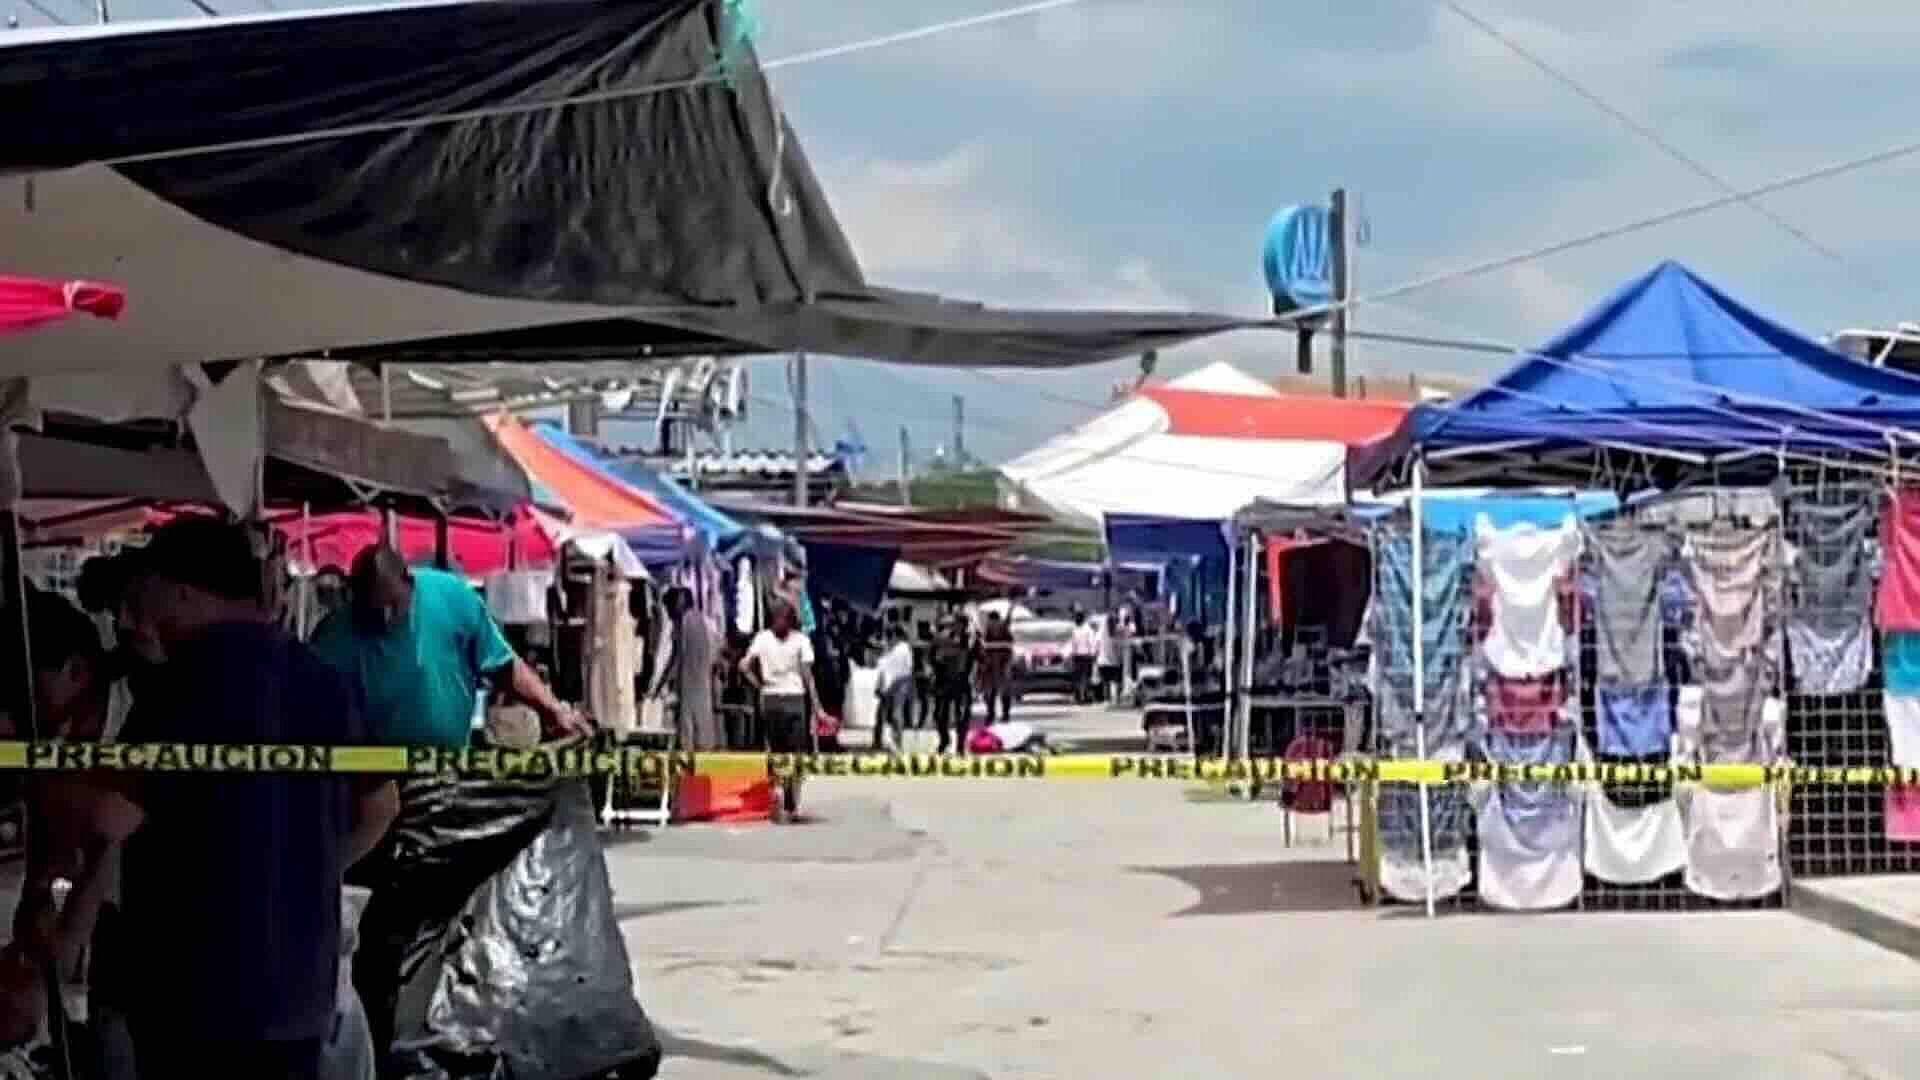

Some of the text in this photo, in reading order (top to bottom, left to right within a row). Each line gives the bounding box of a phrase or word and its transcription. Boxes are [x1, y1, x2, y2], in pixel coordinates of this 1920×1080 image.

[26, 743, 332, 771] PRECAUCION
[406, 747, 694, 777] PRECAUCION
[766, 753, 1045, 778] PRECAUCION
[1109, 757, 1379, 780] PRECAUCION
[1443, 762, 1702, 783] PRECAUCION
